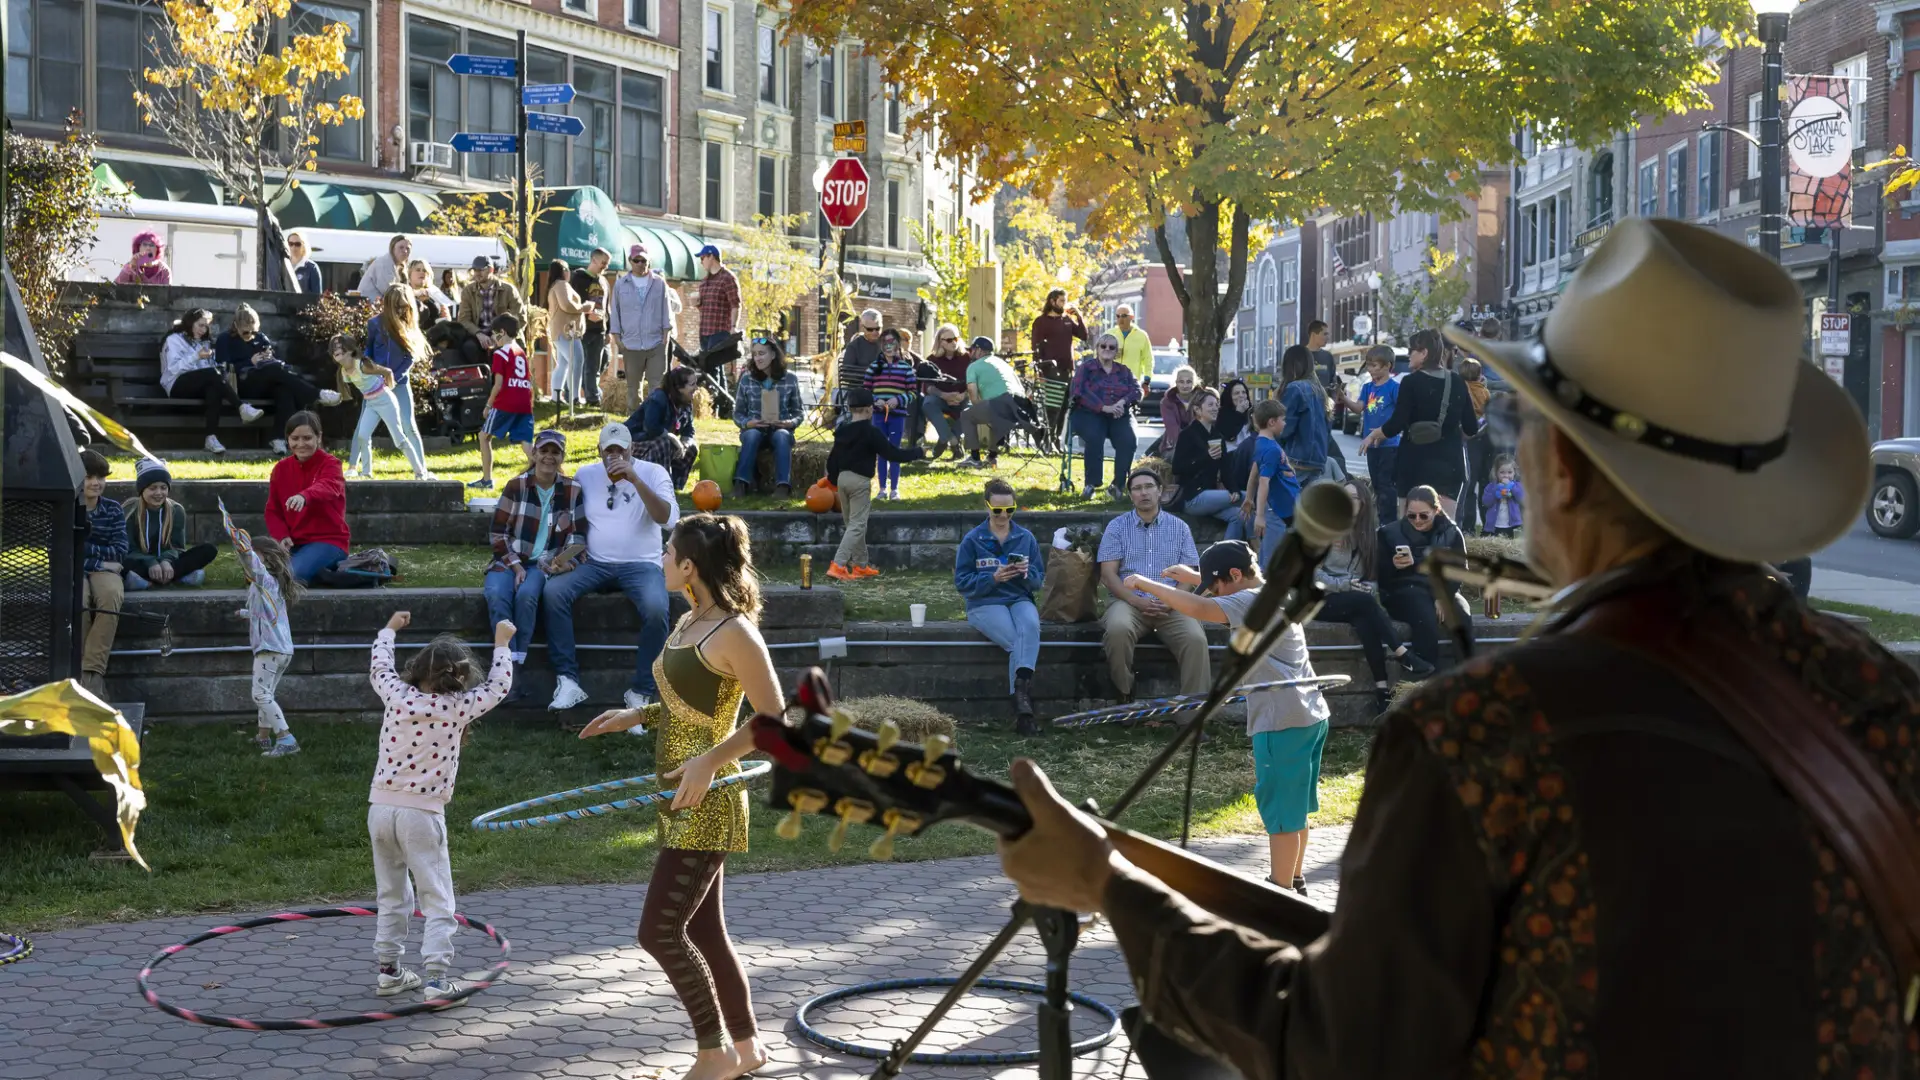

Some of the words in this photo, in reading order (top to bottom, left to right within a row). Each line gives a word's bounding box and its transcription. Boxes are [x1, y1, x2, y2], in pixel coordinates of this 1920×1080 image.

[1793, 119, 1847, 150] SARANAC
[1808, 136, 1835, 155] LAKE
[824, 179, 866, 206] STOP
[588, 233, 598, 246] 86
[1822, 317, 1848, 329] STOP
[515, 355, 526, 378] 9
